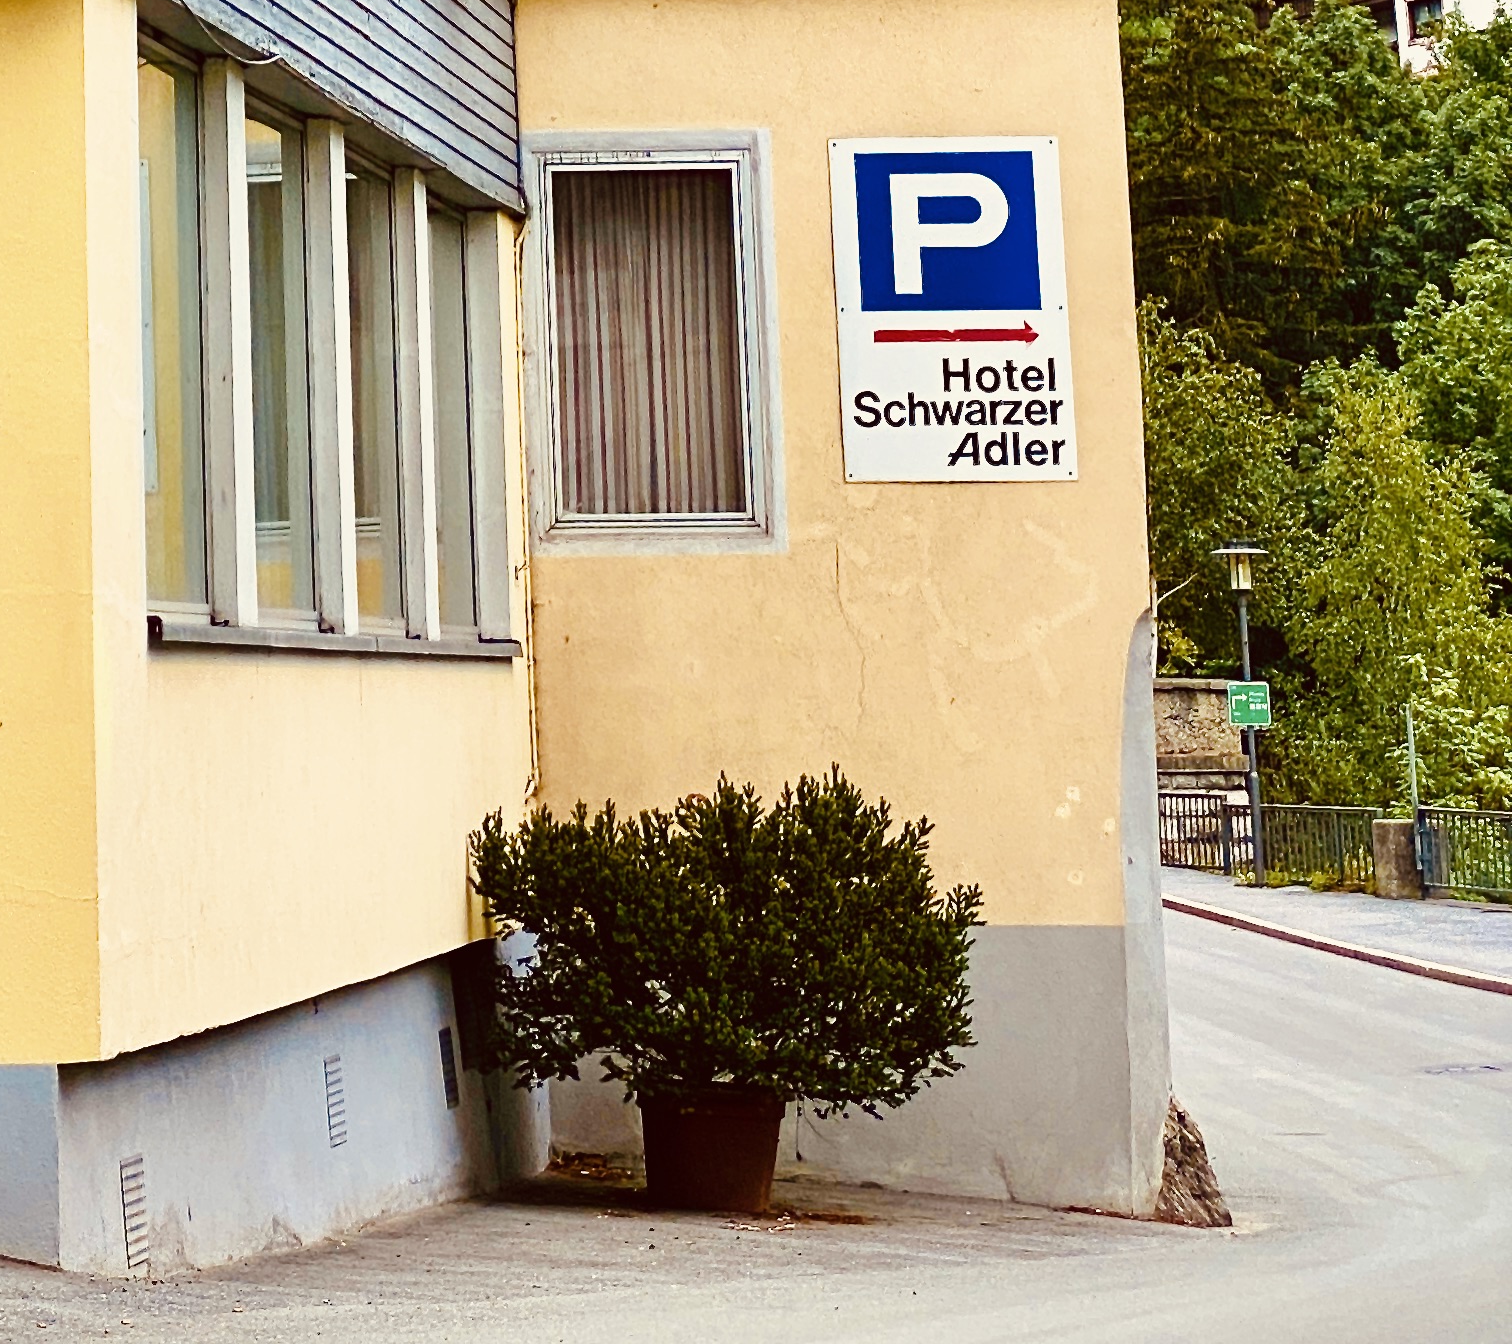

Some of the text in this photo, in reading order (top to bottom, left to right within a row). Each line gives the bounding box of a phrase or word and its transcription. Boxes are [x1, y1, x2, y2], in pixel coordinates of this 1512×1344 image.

[889, 172, 1010, 295] P
[941, 357, 1057, 393] Hotel
[853, 390, 1064, 429] Schwarzer
[947, 431, 1066, 467] Adler
